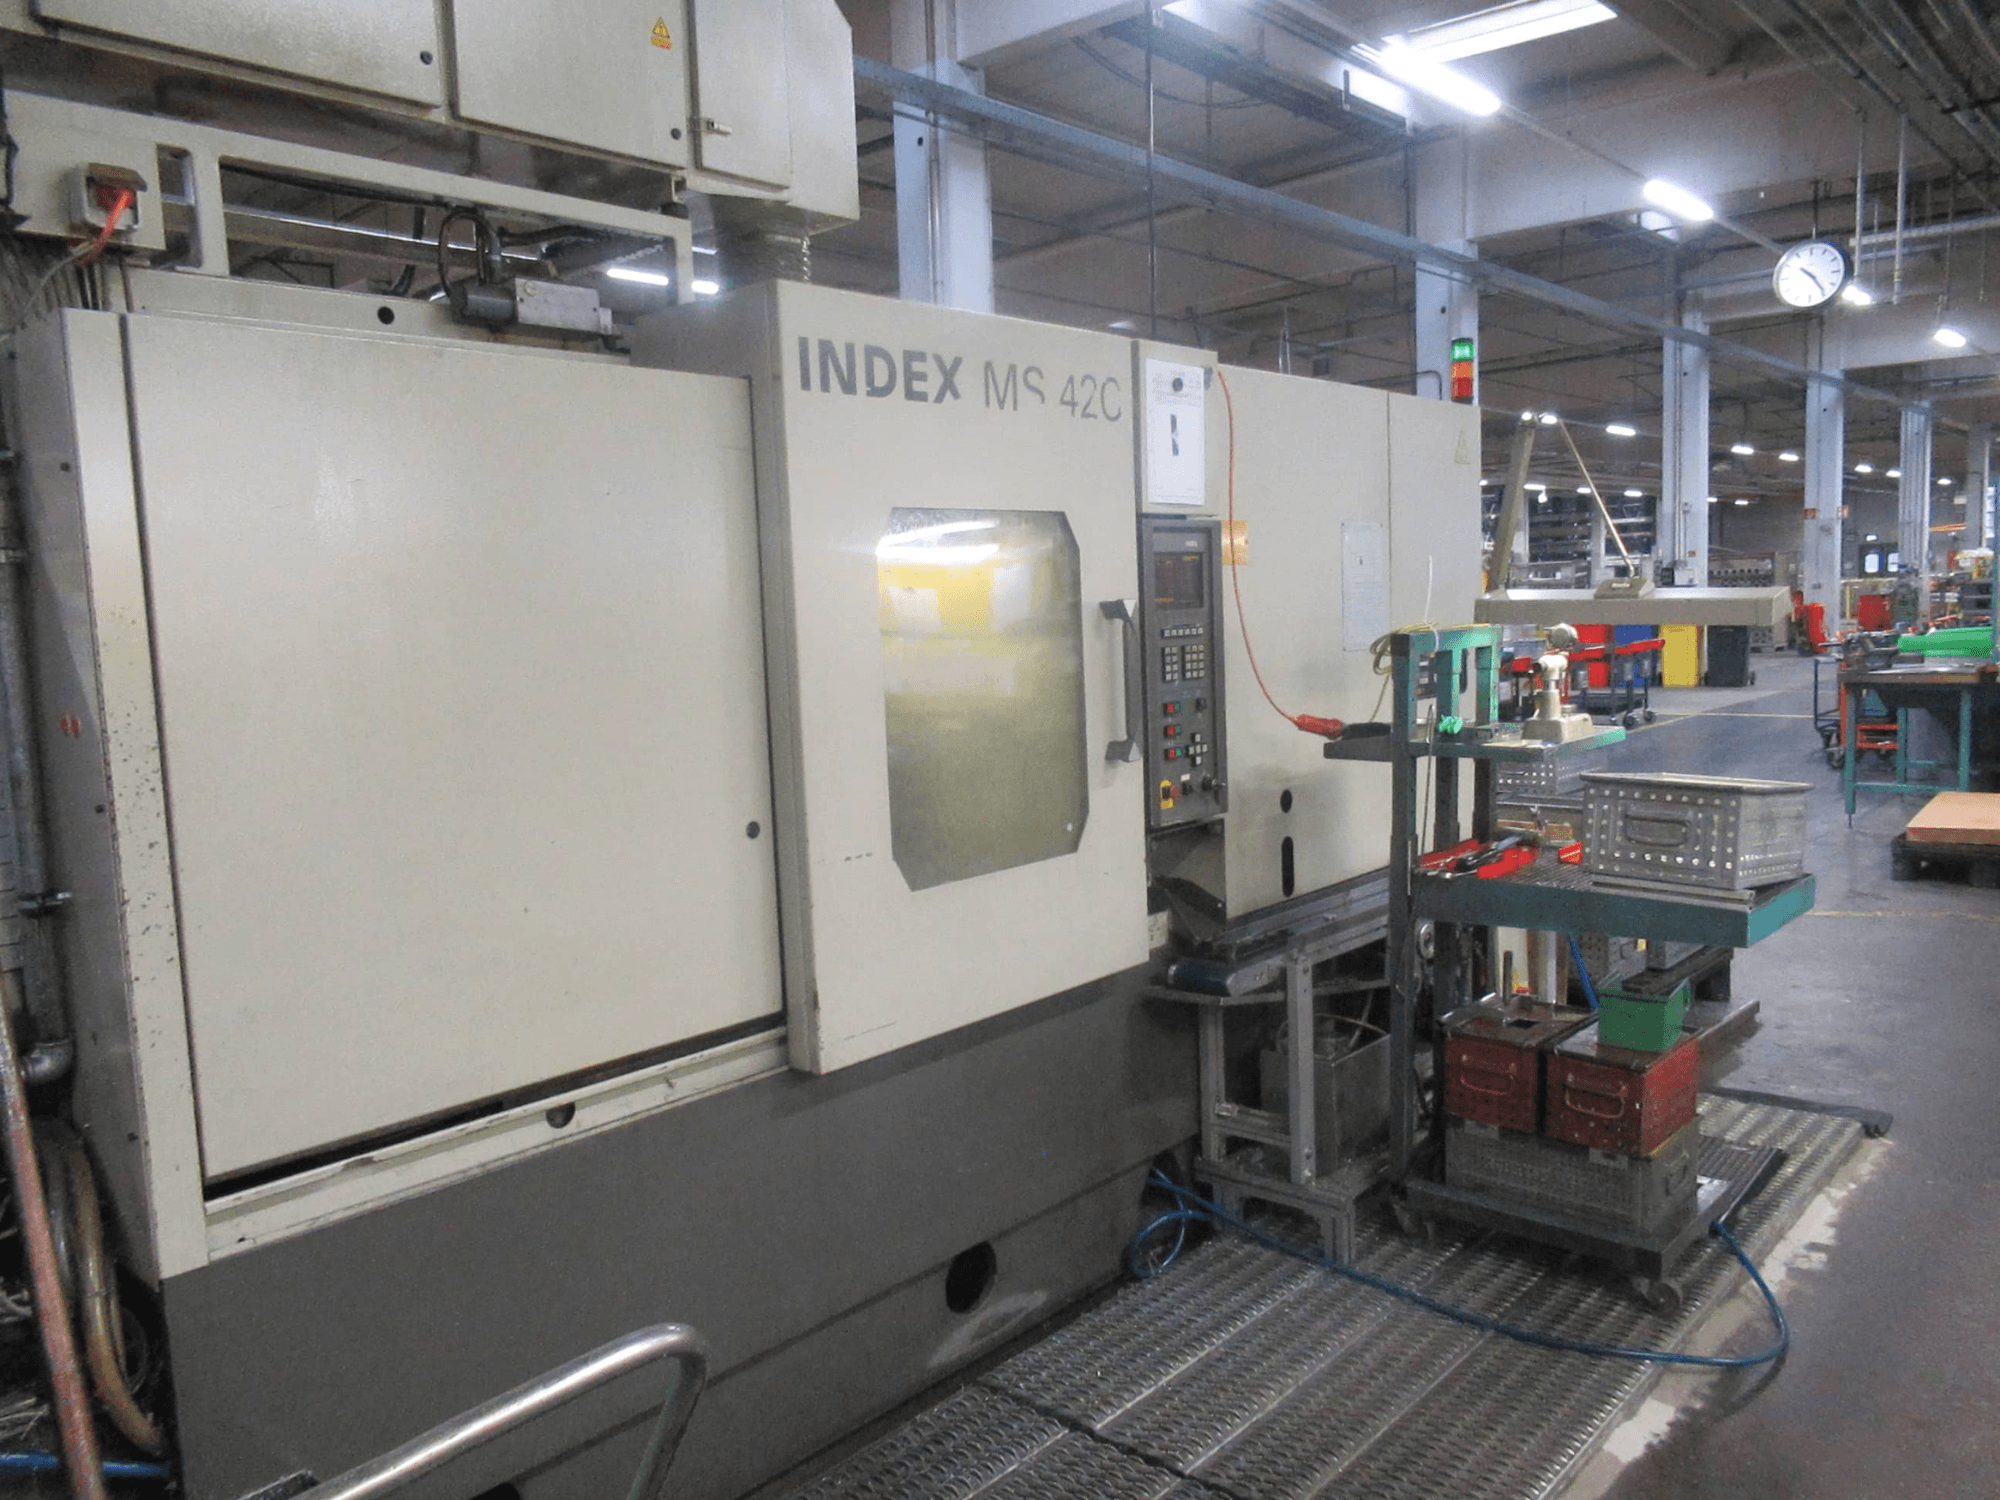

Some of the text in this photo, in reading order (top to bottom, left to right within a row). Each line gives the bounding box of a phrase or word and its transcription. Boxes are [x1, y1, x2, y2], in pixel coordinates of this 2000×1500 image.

[798, 336, 963, 404] INDEX
[983, 360, 1046, 411] MS
[1059, 374, 1122, 422] 42C
